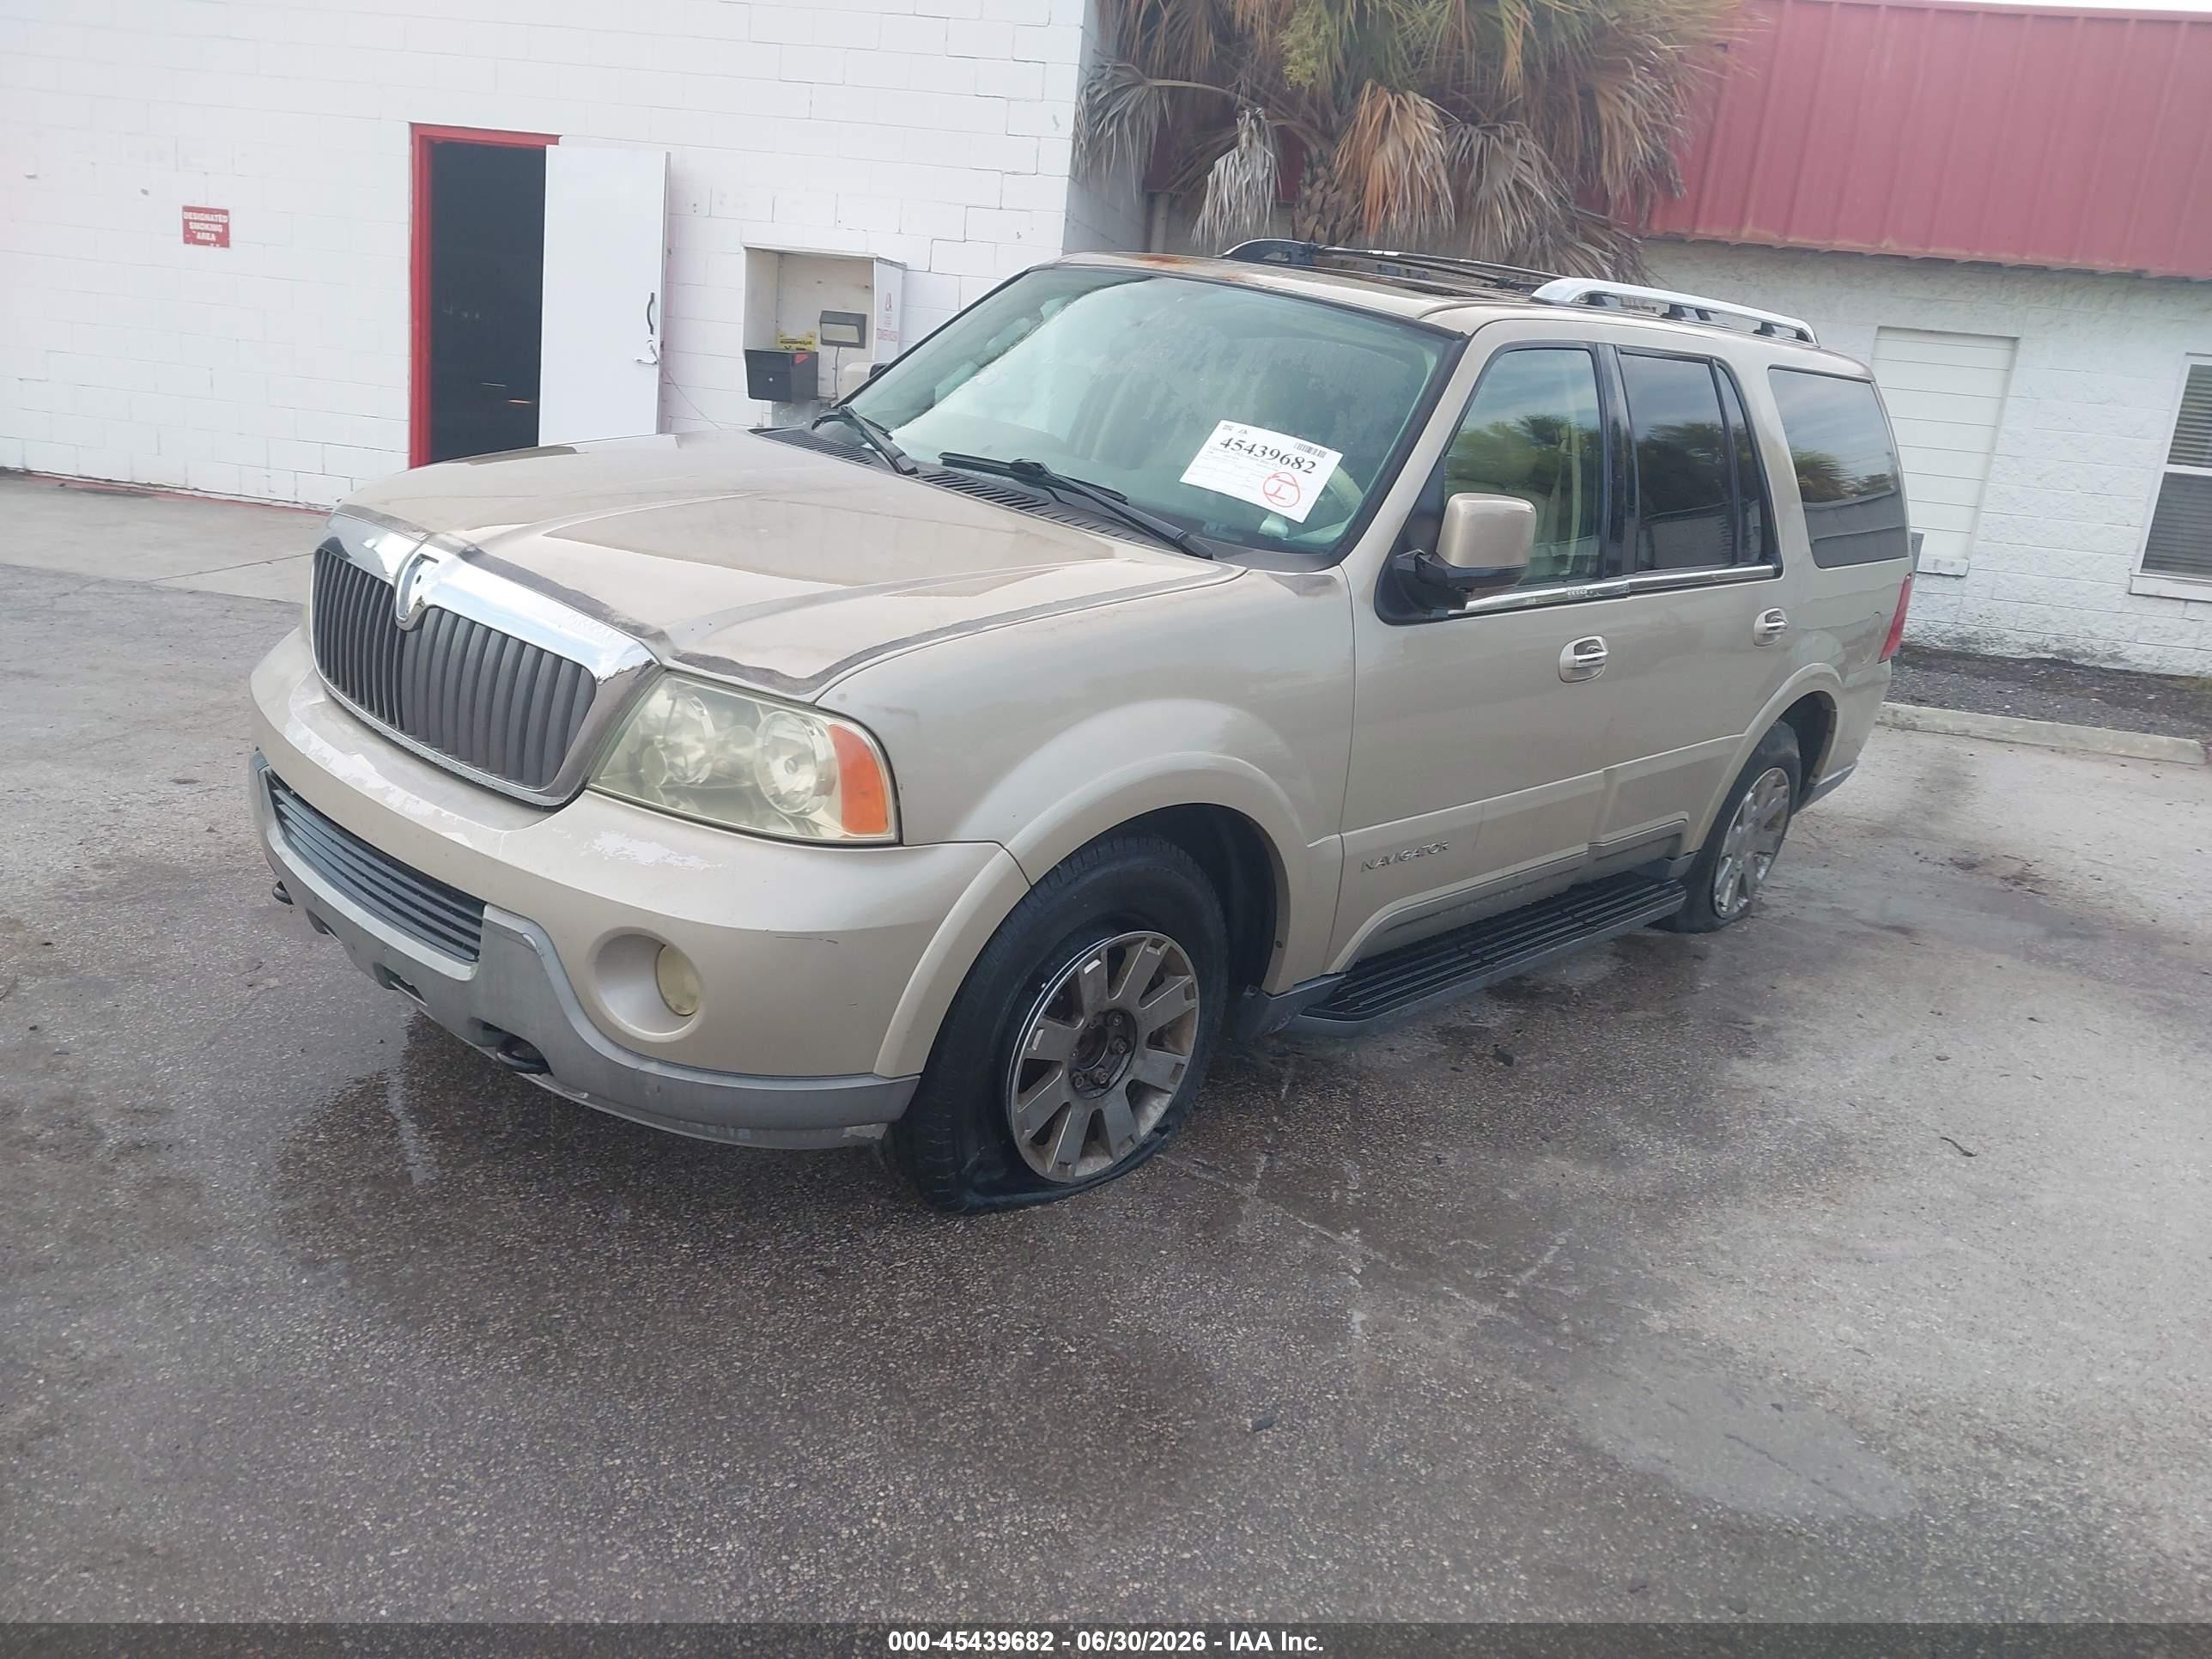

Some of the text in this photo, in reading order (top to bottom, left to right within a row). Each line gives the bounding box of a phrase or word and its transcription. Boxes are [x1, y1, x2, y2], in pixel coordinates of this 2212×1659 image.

[184, 211, 228, 223] DESIGNATED
[189, 222, 222, 233] SMOKING
[197, 232, 216, 241] AREA
[1219, 437, 1316, 474] 45439682
[1360, 841, 1449, 872] NAVIGATOR
